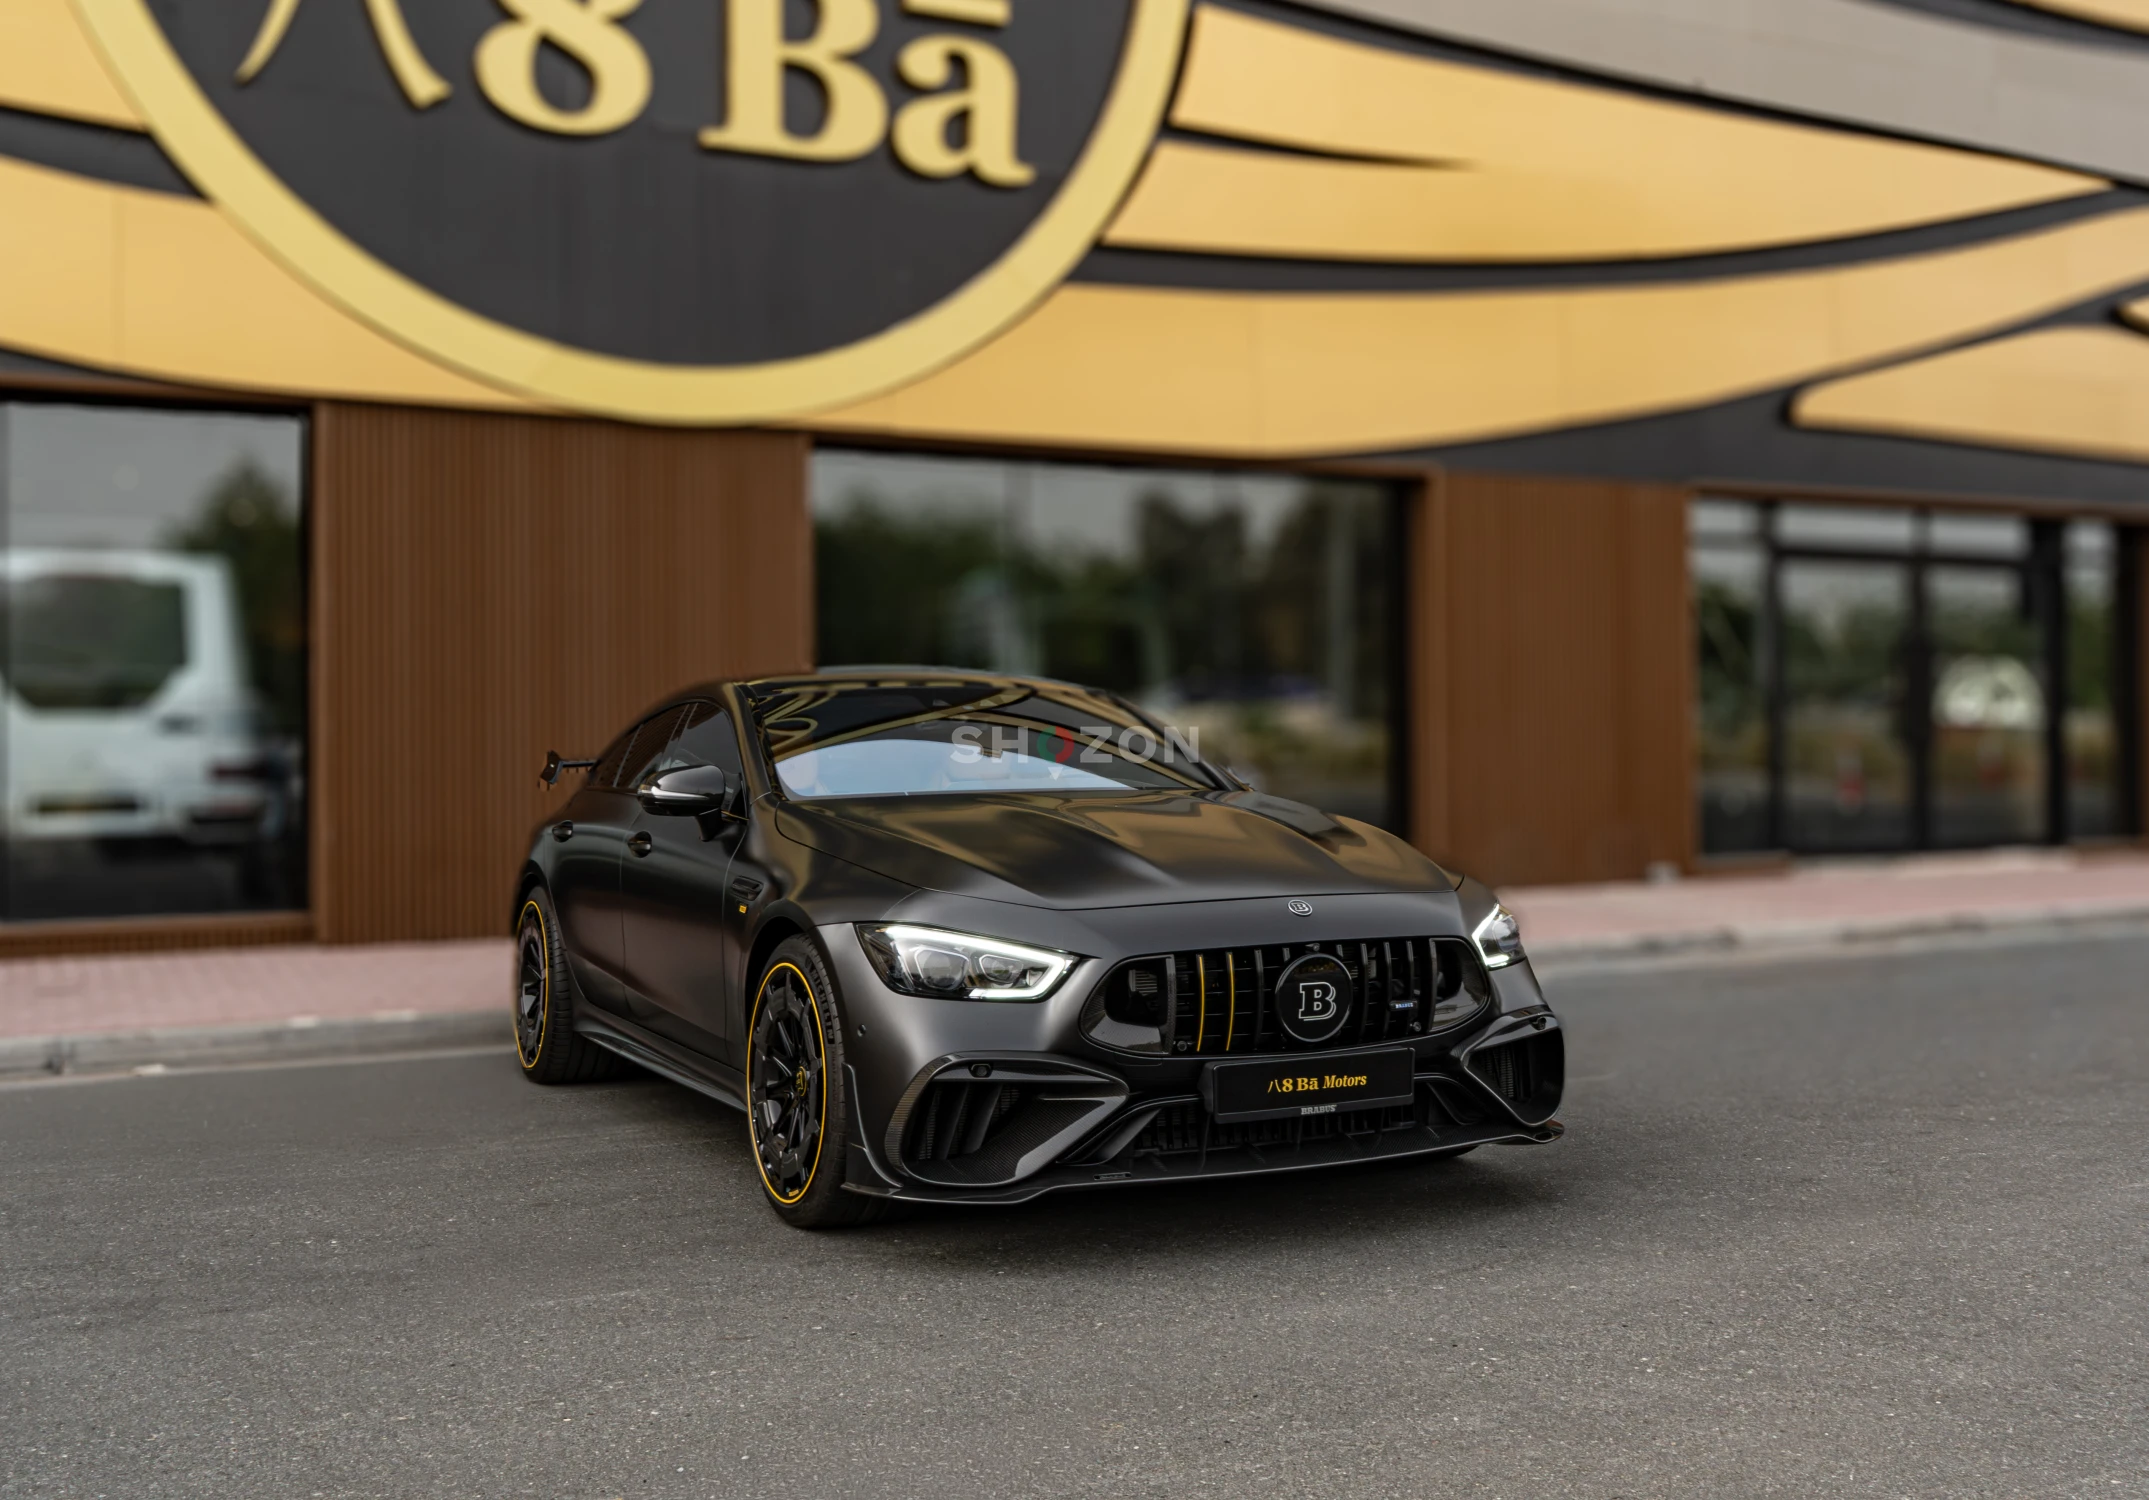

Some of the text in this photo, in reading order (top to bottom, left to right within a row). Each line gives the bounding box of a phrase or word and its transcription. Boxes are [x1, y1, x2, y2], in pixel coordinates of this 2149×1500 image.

[1298, 981, 1337, 1022] B
[1323, 1074, 1368, 1090] Motors
[1300, 1105, 1337, 1116] BRABUS
